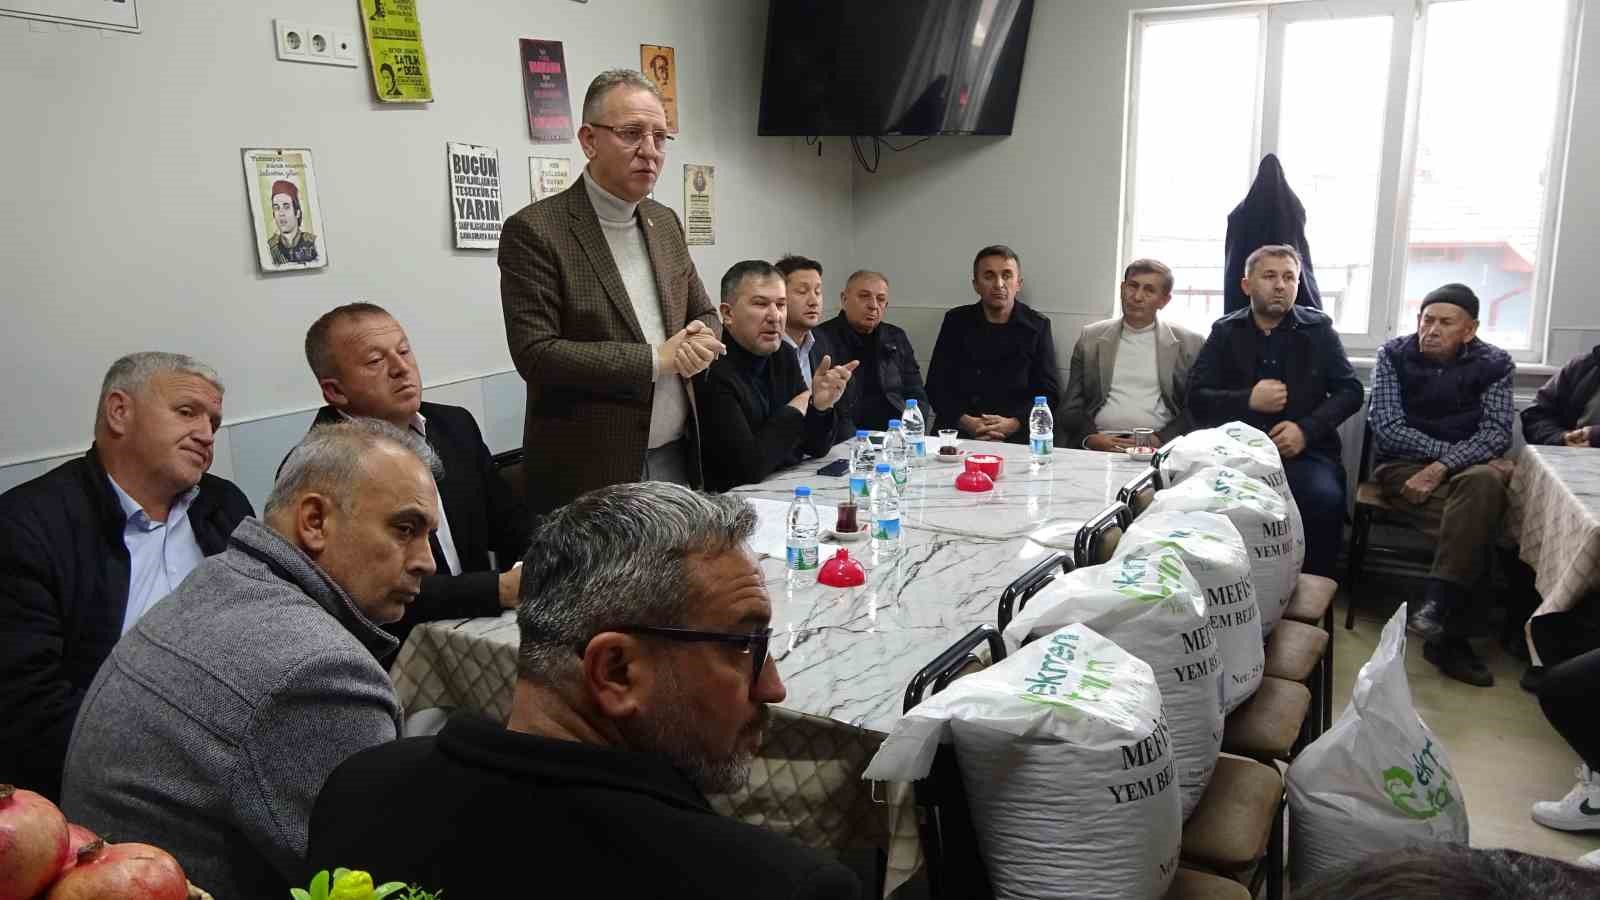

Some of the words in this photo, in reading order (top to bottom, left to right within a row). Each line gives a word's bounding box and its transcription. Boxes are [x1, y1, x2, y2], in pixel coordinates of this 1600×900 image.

[452, 153, 497, 177] BUGÜN
[456, 198, 499, 220] YARIN
[1174, 659, 1208, 682] YEM
[1108, 777, 1154, 804] YEM
